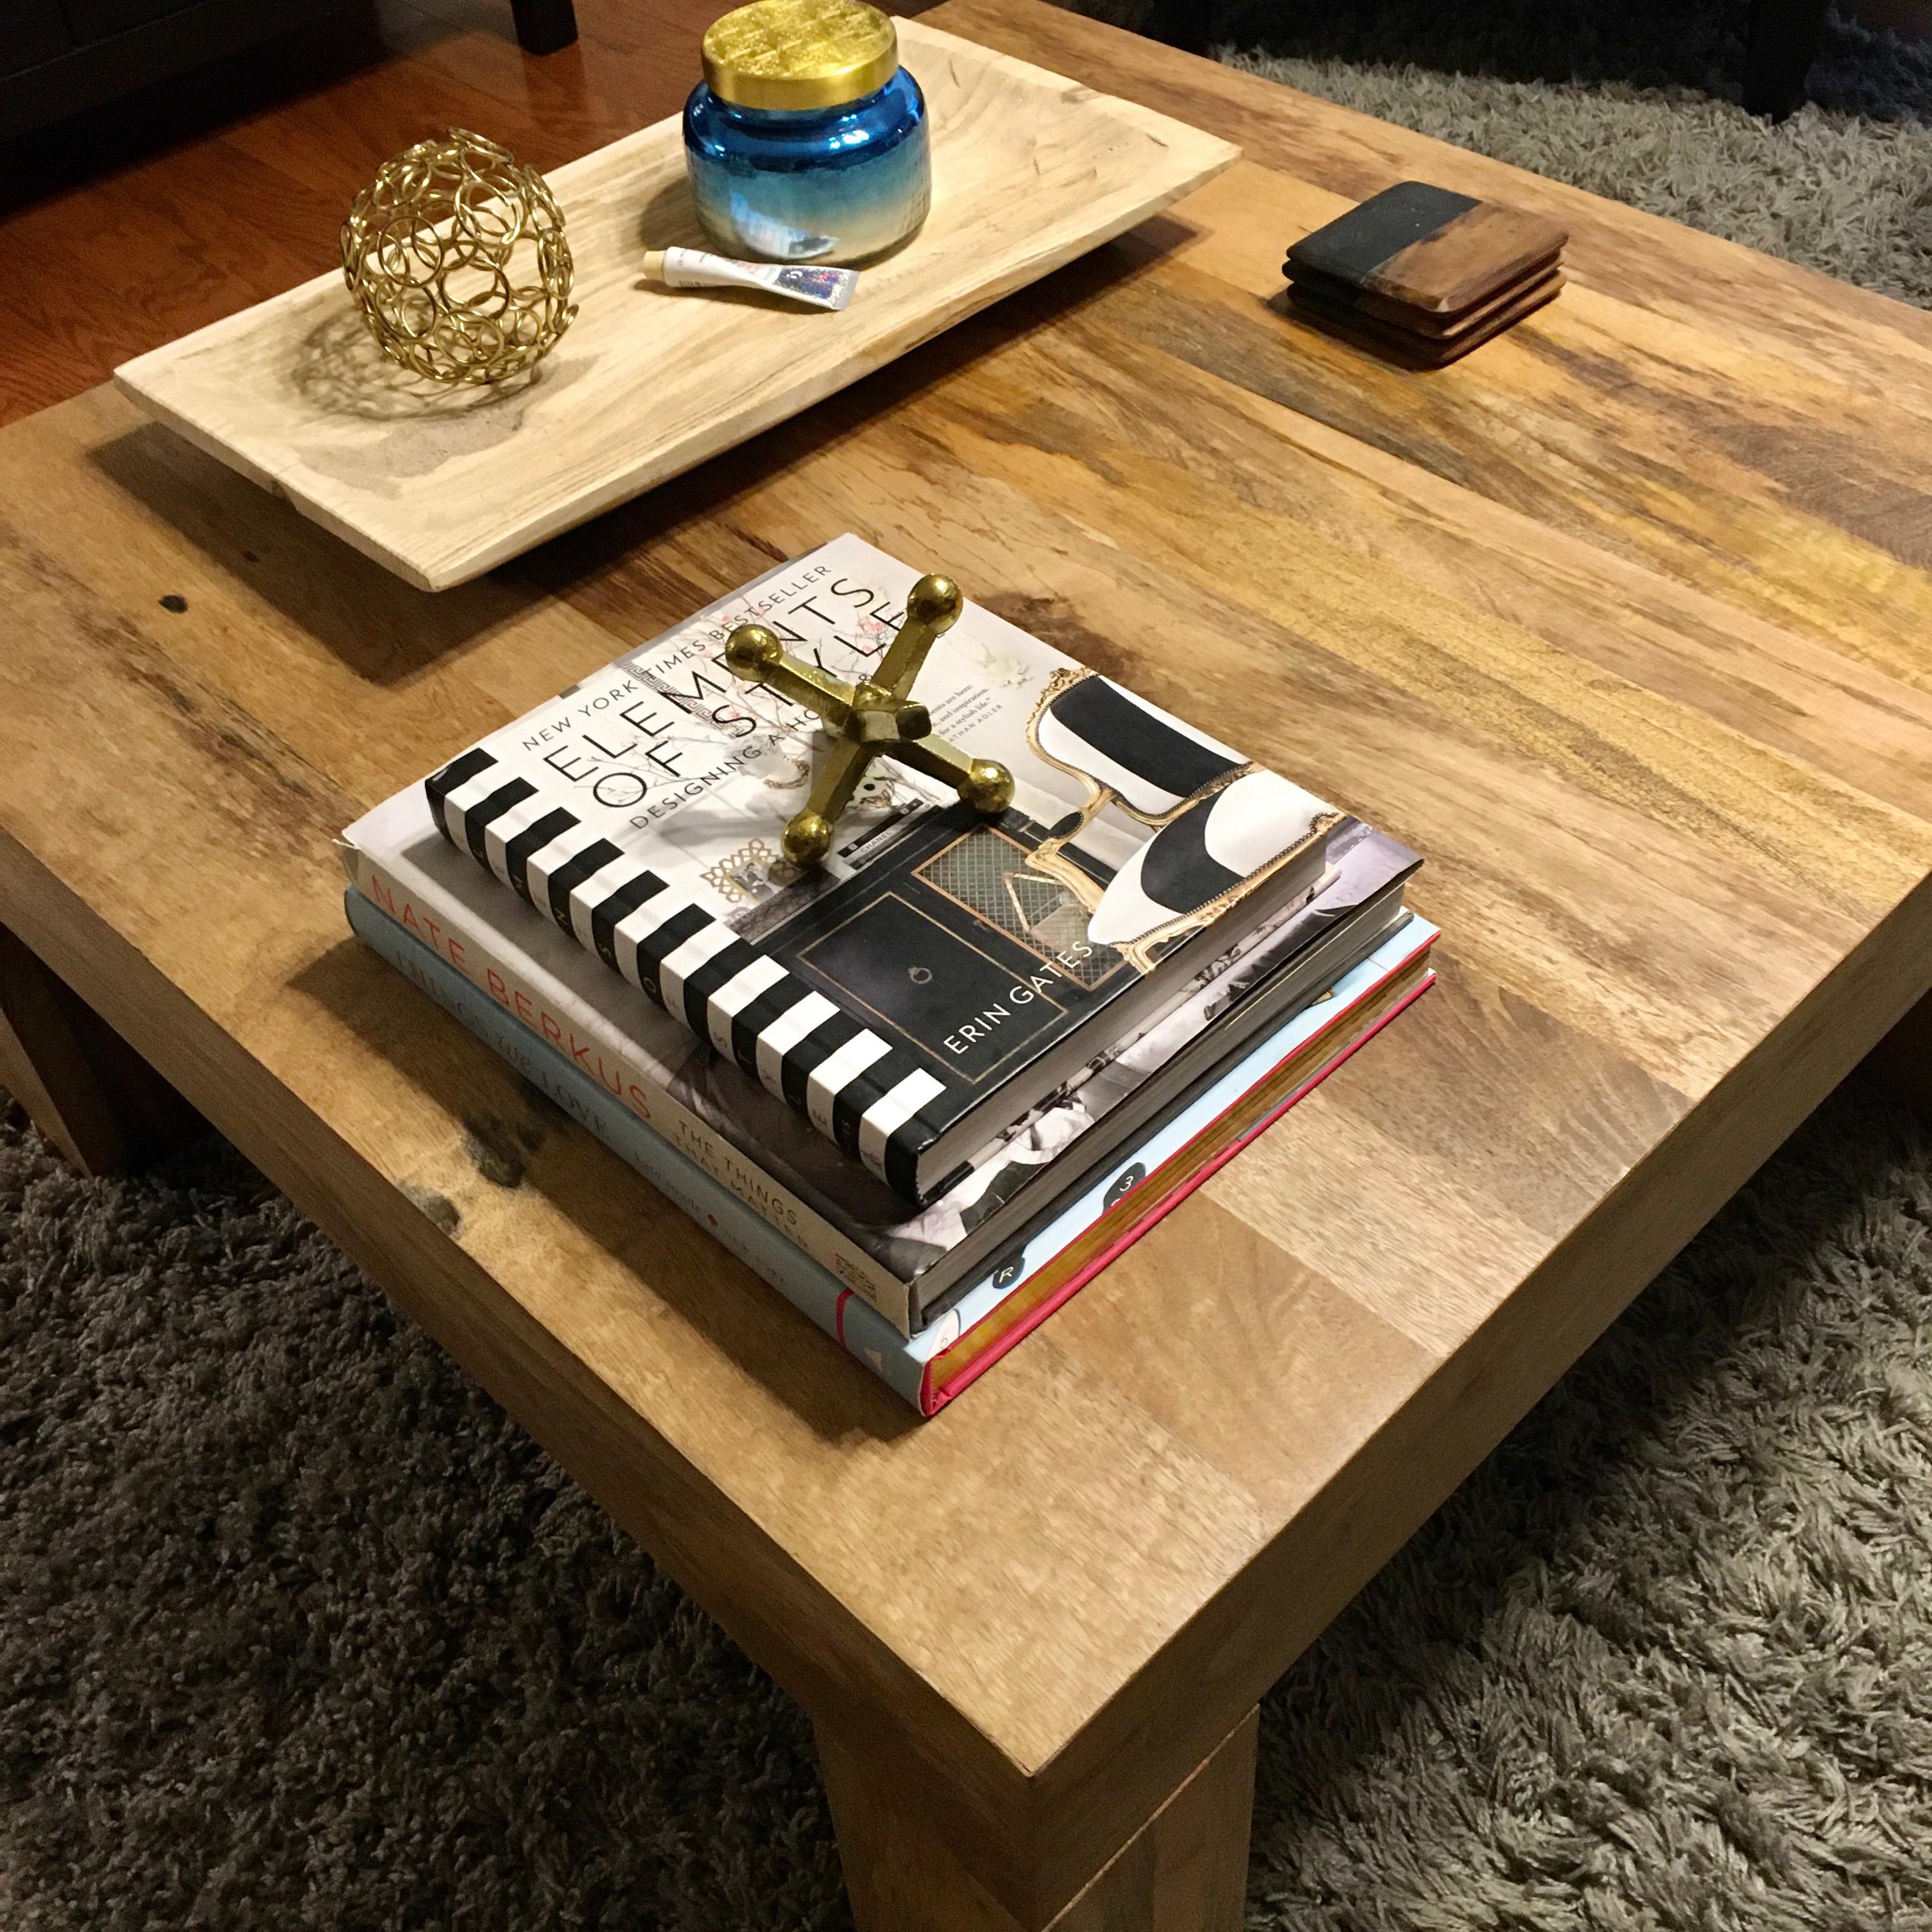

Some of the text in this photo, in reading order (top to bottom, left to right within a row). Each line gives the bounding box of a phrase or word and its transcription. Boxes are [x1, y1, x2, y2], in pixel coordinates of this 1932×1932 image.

[522, 565, 832, 752] NEW YORK TIMES BESTSELLER
[940, 710, 954, 723] and
[956, 707, 978, 727] stylish
[977, 704, 1003, 723] ADLER
[593, 740, 684, 808] OF
[629, 746, 762, 830] DESIGNING
[768, 734, 786, 746] A
[860, 831, 893, 853] CHANEL
[371, 874, 652, 1121] NATE BERKUS
[943, 940, 1093, 1055] ERIN GATES
[672, 1132, 719, 1177] THAT
[678, 1119, 714, 1158] THE
[724, 1156, 797, 1226] THINGS
